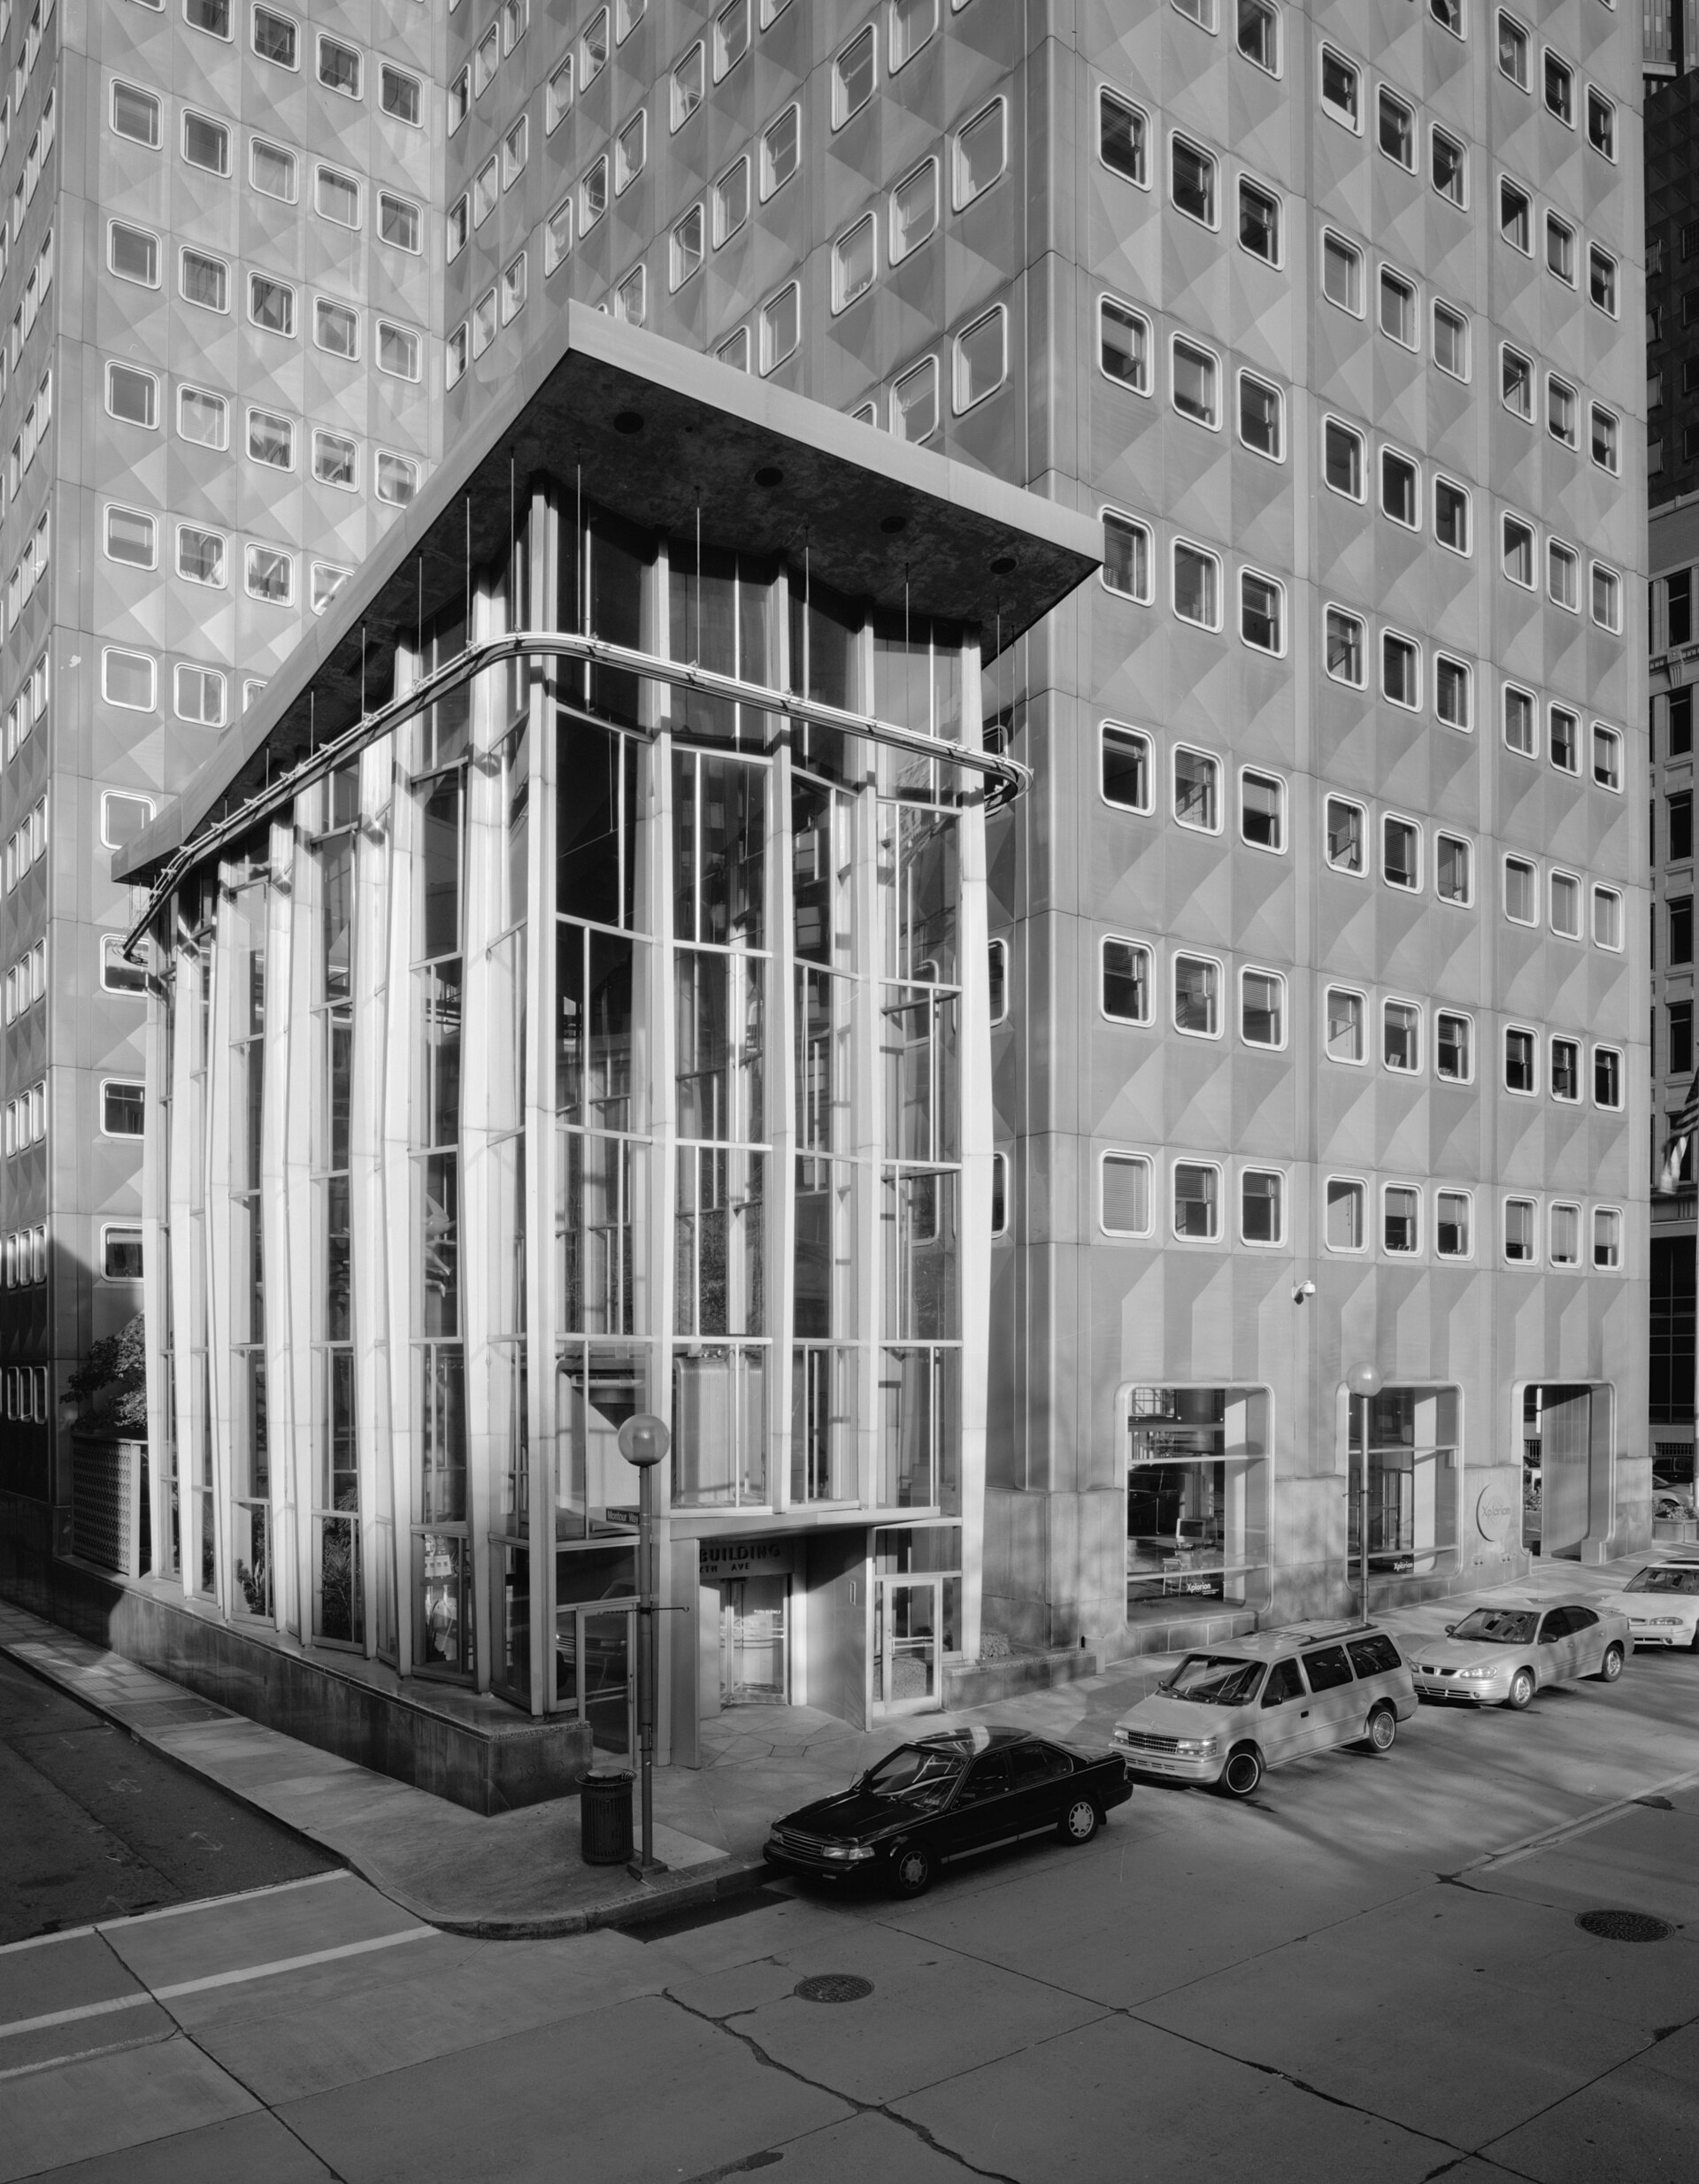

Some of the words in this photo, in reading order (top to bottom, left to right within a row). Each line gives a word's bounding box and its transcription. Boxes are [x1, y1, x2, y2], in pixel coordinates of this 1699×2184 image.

[607, 1509, 627, 1522] Montour
[628, 1512, 639, 1526] Way
[700, 1543, 780, 1563] BUILDING
[731, 1562, 750, 1571] AVE
[1186, 1581, 1211, 1594] Xplorion
